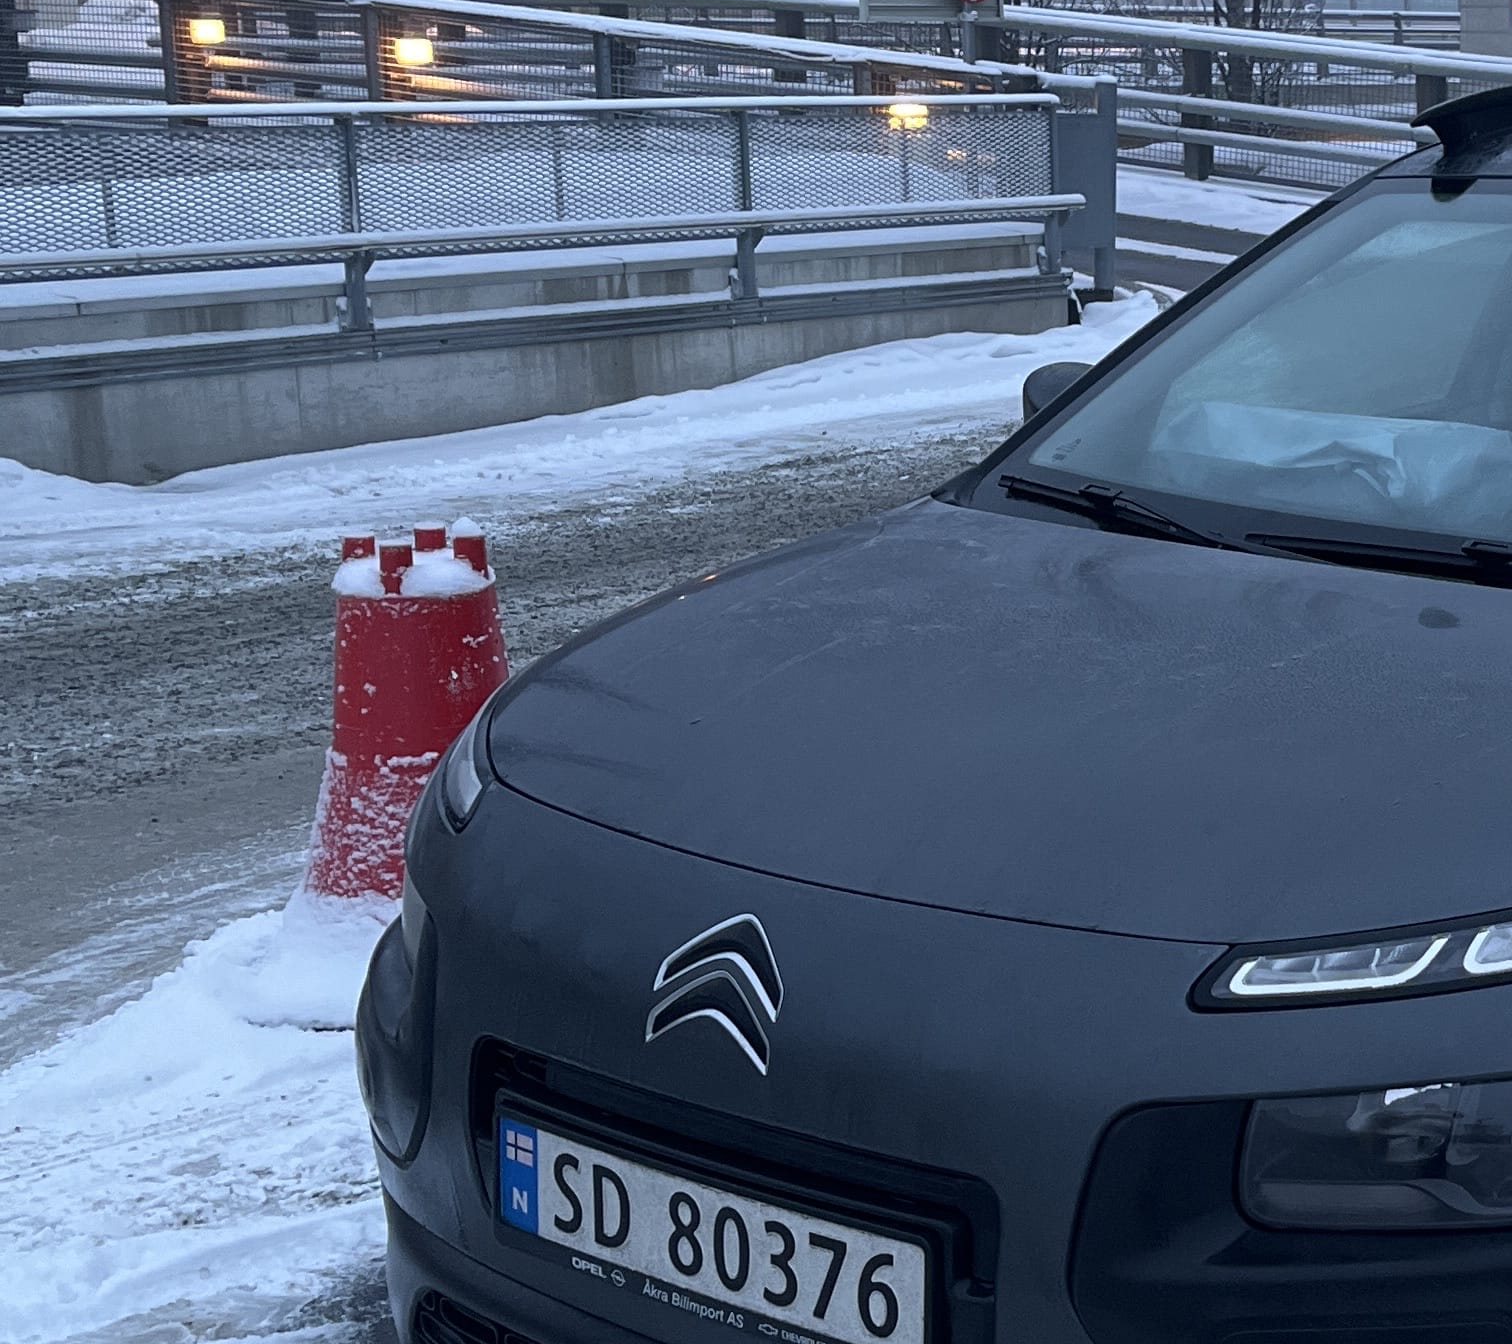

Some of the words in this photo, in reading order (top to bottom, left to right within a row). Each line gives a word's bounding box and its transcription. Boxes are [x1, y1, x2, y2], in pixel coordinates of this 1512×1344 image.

[511, 1185, 528, 1214] N
[554, 1153, 631, 1248] SD
[667, 1191, 899, 1338] 80376
[571, 1256, 607, 1279] OPEL
[642, 1278, 669, 1303] Åkra
[726, 1311, 744, 1328] AS
